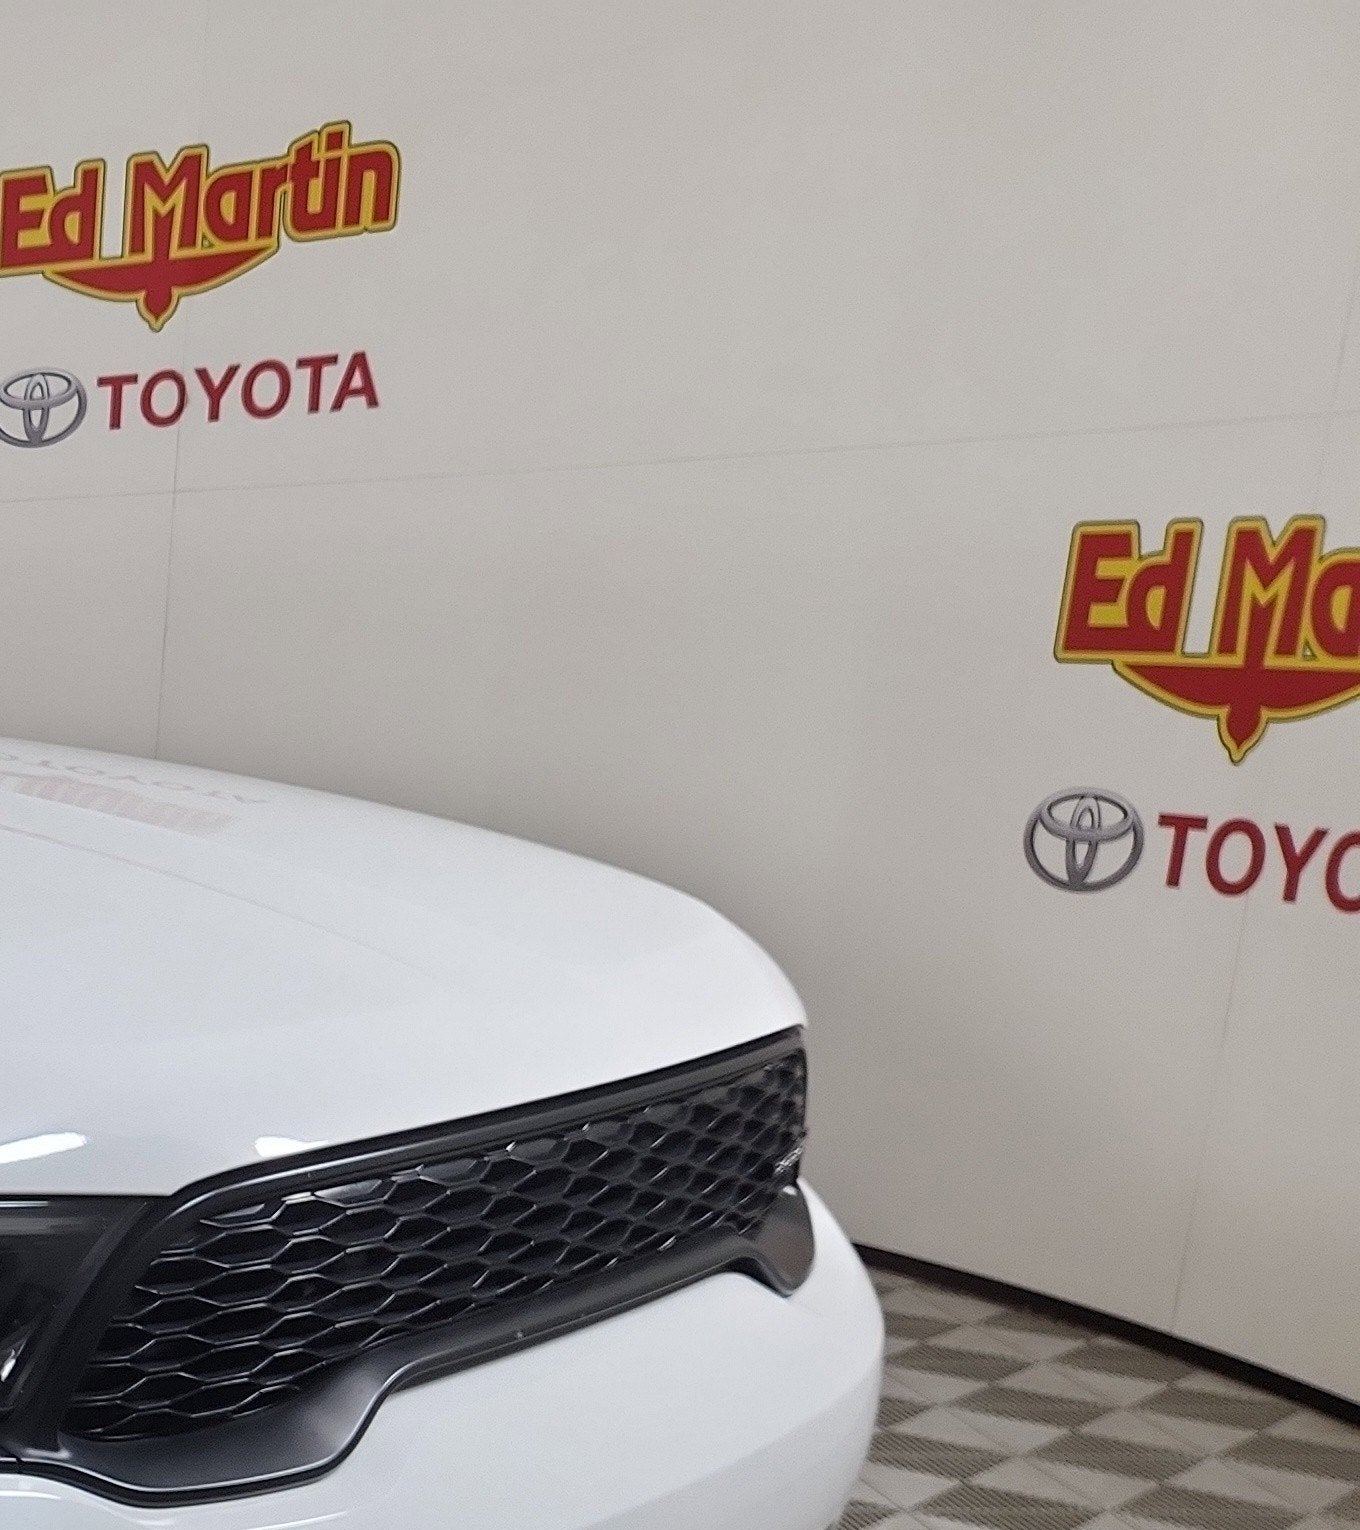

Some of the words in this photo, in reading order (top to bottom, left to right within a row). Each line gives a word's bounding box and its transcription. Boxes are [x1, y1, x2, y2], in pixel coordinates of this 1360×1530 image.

[123, 120, 400, 261] Martin
[96, 351, 380, 431] TOYOTA
[1054, 517, 1204, 663] Ed
